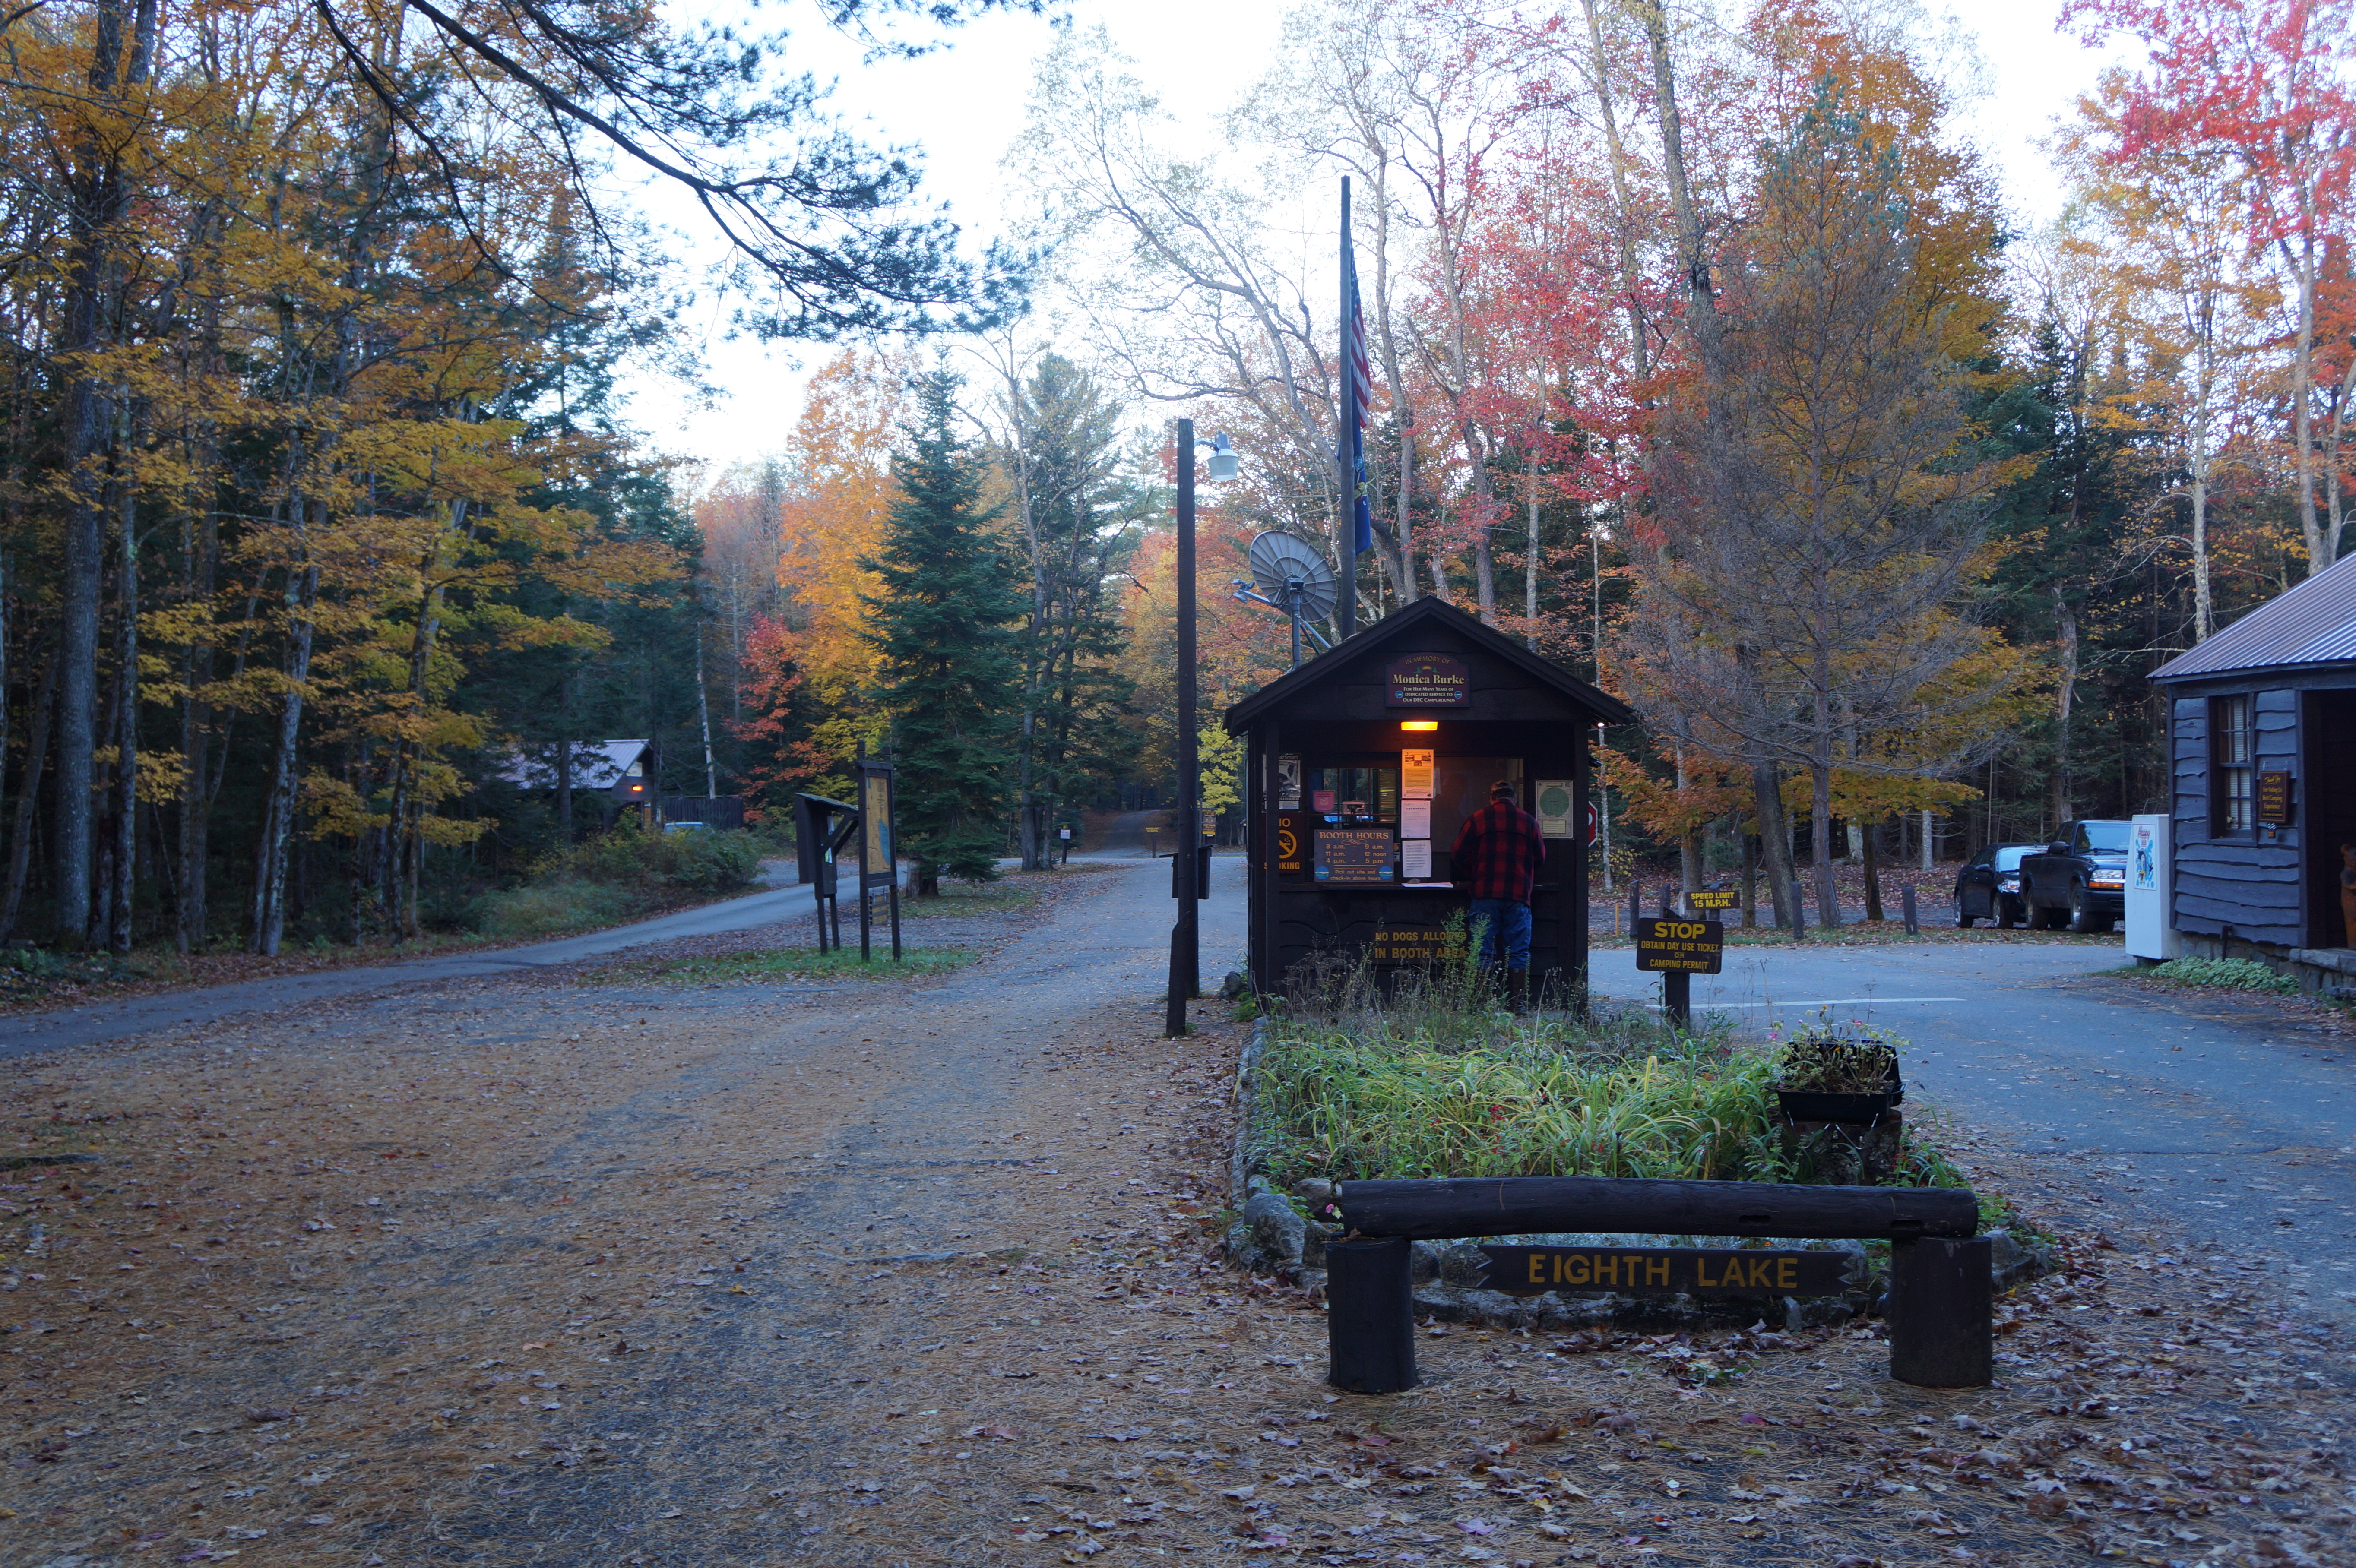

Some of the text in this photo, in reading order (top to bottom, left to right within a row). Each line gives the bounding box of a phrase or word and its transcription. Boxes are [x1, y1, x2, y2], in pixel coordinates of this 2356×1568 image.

[1393, 674, 1464, 684] Monica Burke
[1264, 862, 1300, 870] SKING
[1654, 922, 1706, 939] STOP
[1375, 932, 1389, 941] NO
[1393, 932, 1419, 941] DOGS
[1641, 940, 1665, 950] OBTAIN
[1667, 942, 1680, 950] DAY
[1697, 943, 1719, 952] TICKET
[1374, 948, 1386, 959] IN
[1392, 948, 1430, 959] BOOTH
[1650, 959, 1709, 969] CAMPING PERMIT
[1529, 1254, 1799, 1288] EIGHTH LAKE
